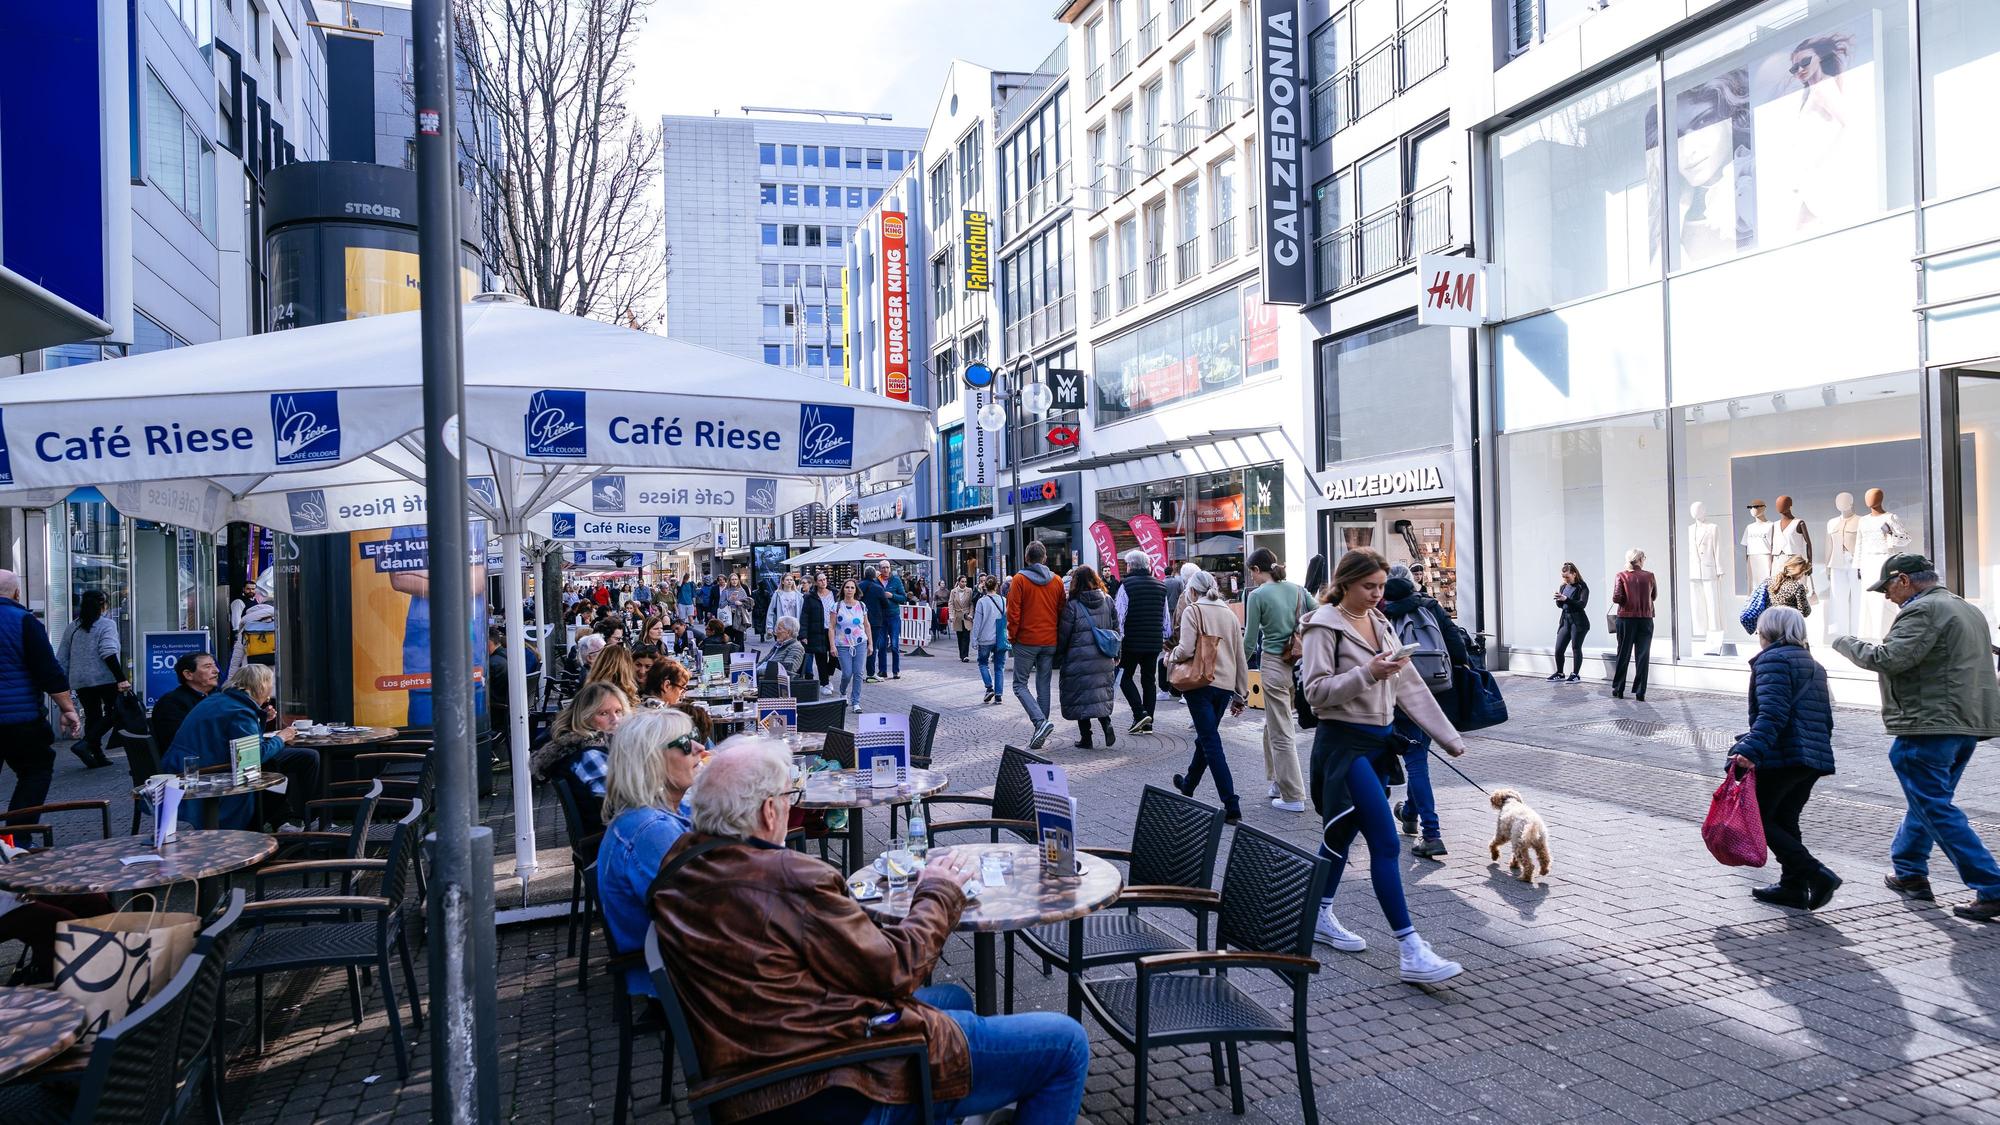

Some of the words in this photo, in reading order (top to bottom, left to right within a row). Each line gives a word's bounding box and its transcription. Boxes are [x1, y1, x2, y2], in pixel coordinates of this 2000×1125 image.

[1268, 11, 1299, 267] CALZEDONIA
[344, 202, 401, 219] STRÖER
[965, 212, 986, 290] Fahrschule
[887, 249, 902, 293] KING
[1427, 271, 1475, 312] H&M
[888, 295, 904, 365] BURGER
[1056, 374, 1078, 403] WMF
[280, 411, 332, 448] Riese
[530, 408, 576, 444] Riese
[608, 416, 683, 446] Café
[694, 420, 781, 451] Riese
[804, 423, 844, 457] Riese
[976, 392, 985, 484] blue-tomatom
[35, 424, 131, 463] Café
[144, 422, 254, 456] Riese
[289, 451, 307, 460] CAFÉ
[307, 449, 339, 459] COLOGNE
[538, 445, 554, 453] CAFÉ
[555, 446, 584, 454] COLOGNE
[809, 457, 824, 465] CAFÉ
[1008, 485, 1042, 506] NDSEE
[1257, 479, 1272, 507] WMF
[1323, 466, 1443, 501] CALZEDONIA
[583, 520, 613, 534] Café
[616, 522, 651, 535] Riese
[860, 505, 881, 524] BURGER
[880, 502, 895, 520] KING
[365, 541, 402, 555] Erst
[380, 557, 423, 569] dann
[383, 679, 399, 688] Los
[400, 677, 424, 689] geht's
